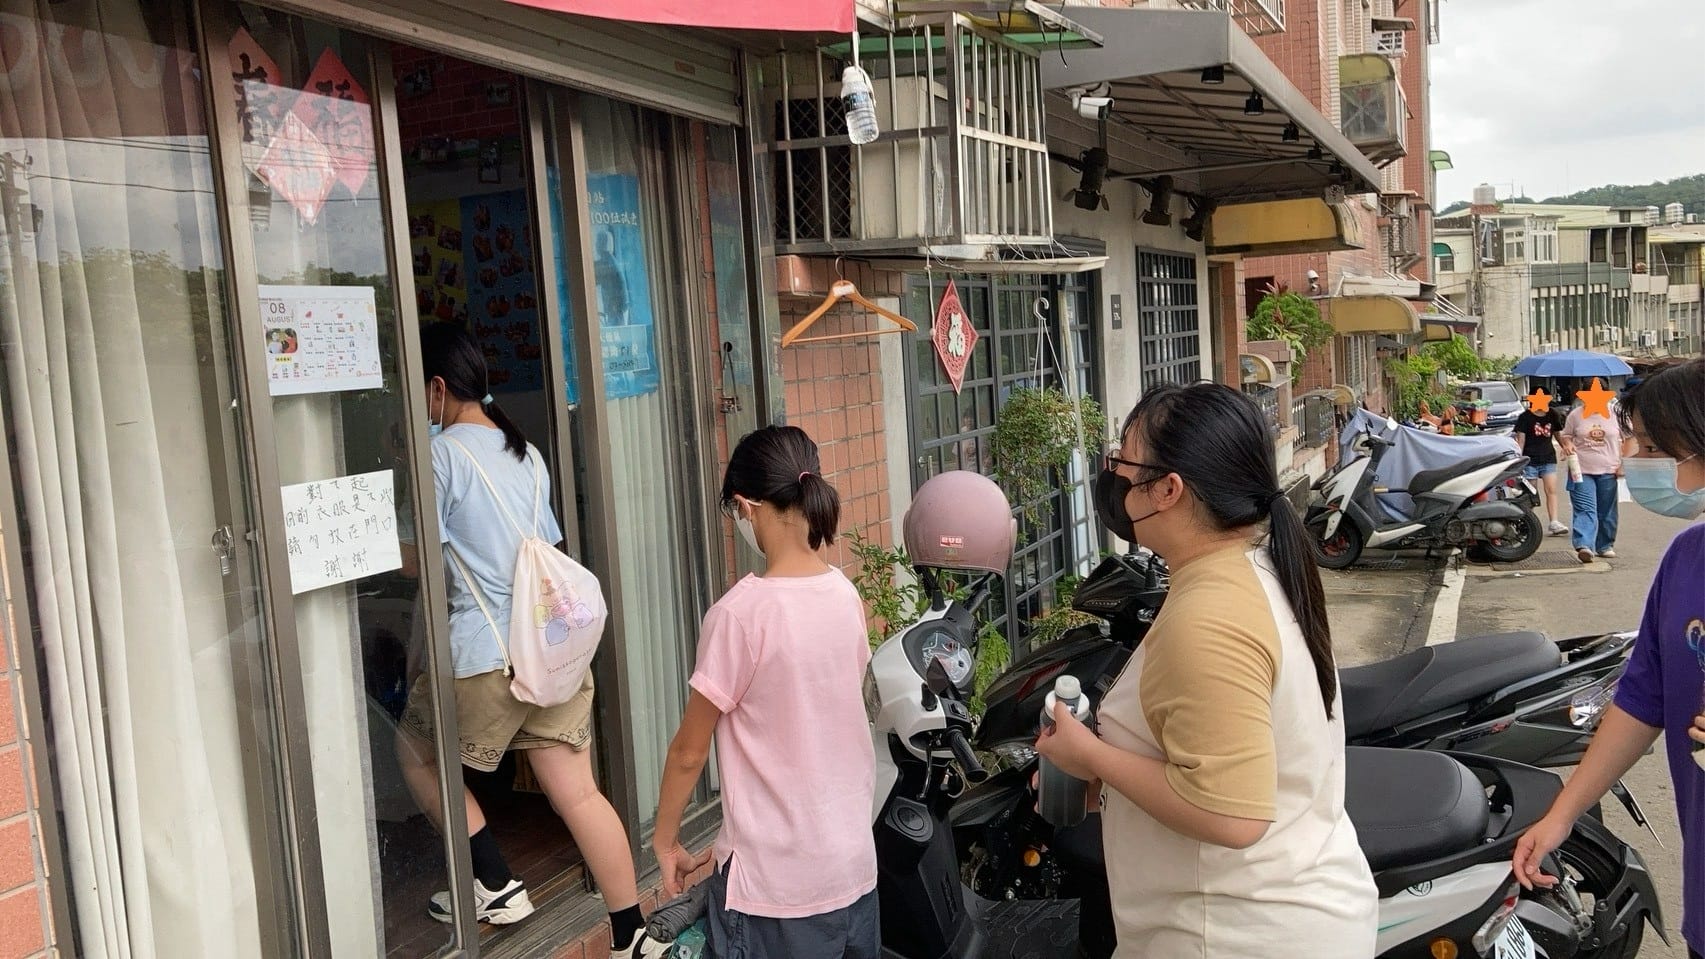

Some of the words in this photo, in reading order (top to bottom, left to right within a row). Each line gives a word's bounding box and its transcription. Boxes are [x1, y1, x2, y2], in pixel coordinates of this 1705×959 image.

[266, 315, 295, 324] AUGUST
[269, 302, 286, 314] 08
[306, 477, 369, 505] 對不起
[287, 514, 392, 556] 請勿放在門口
[324, 547, 369, 578] 謝謝
